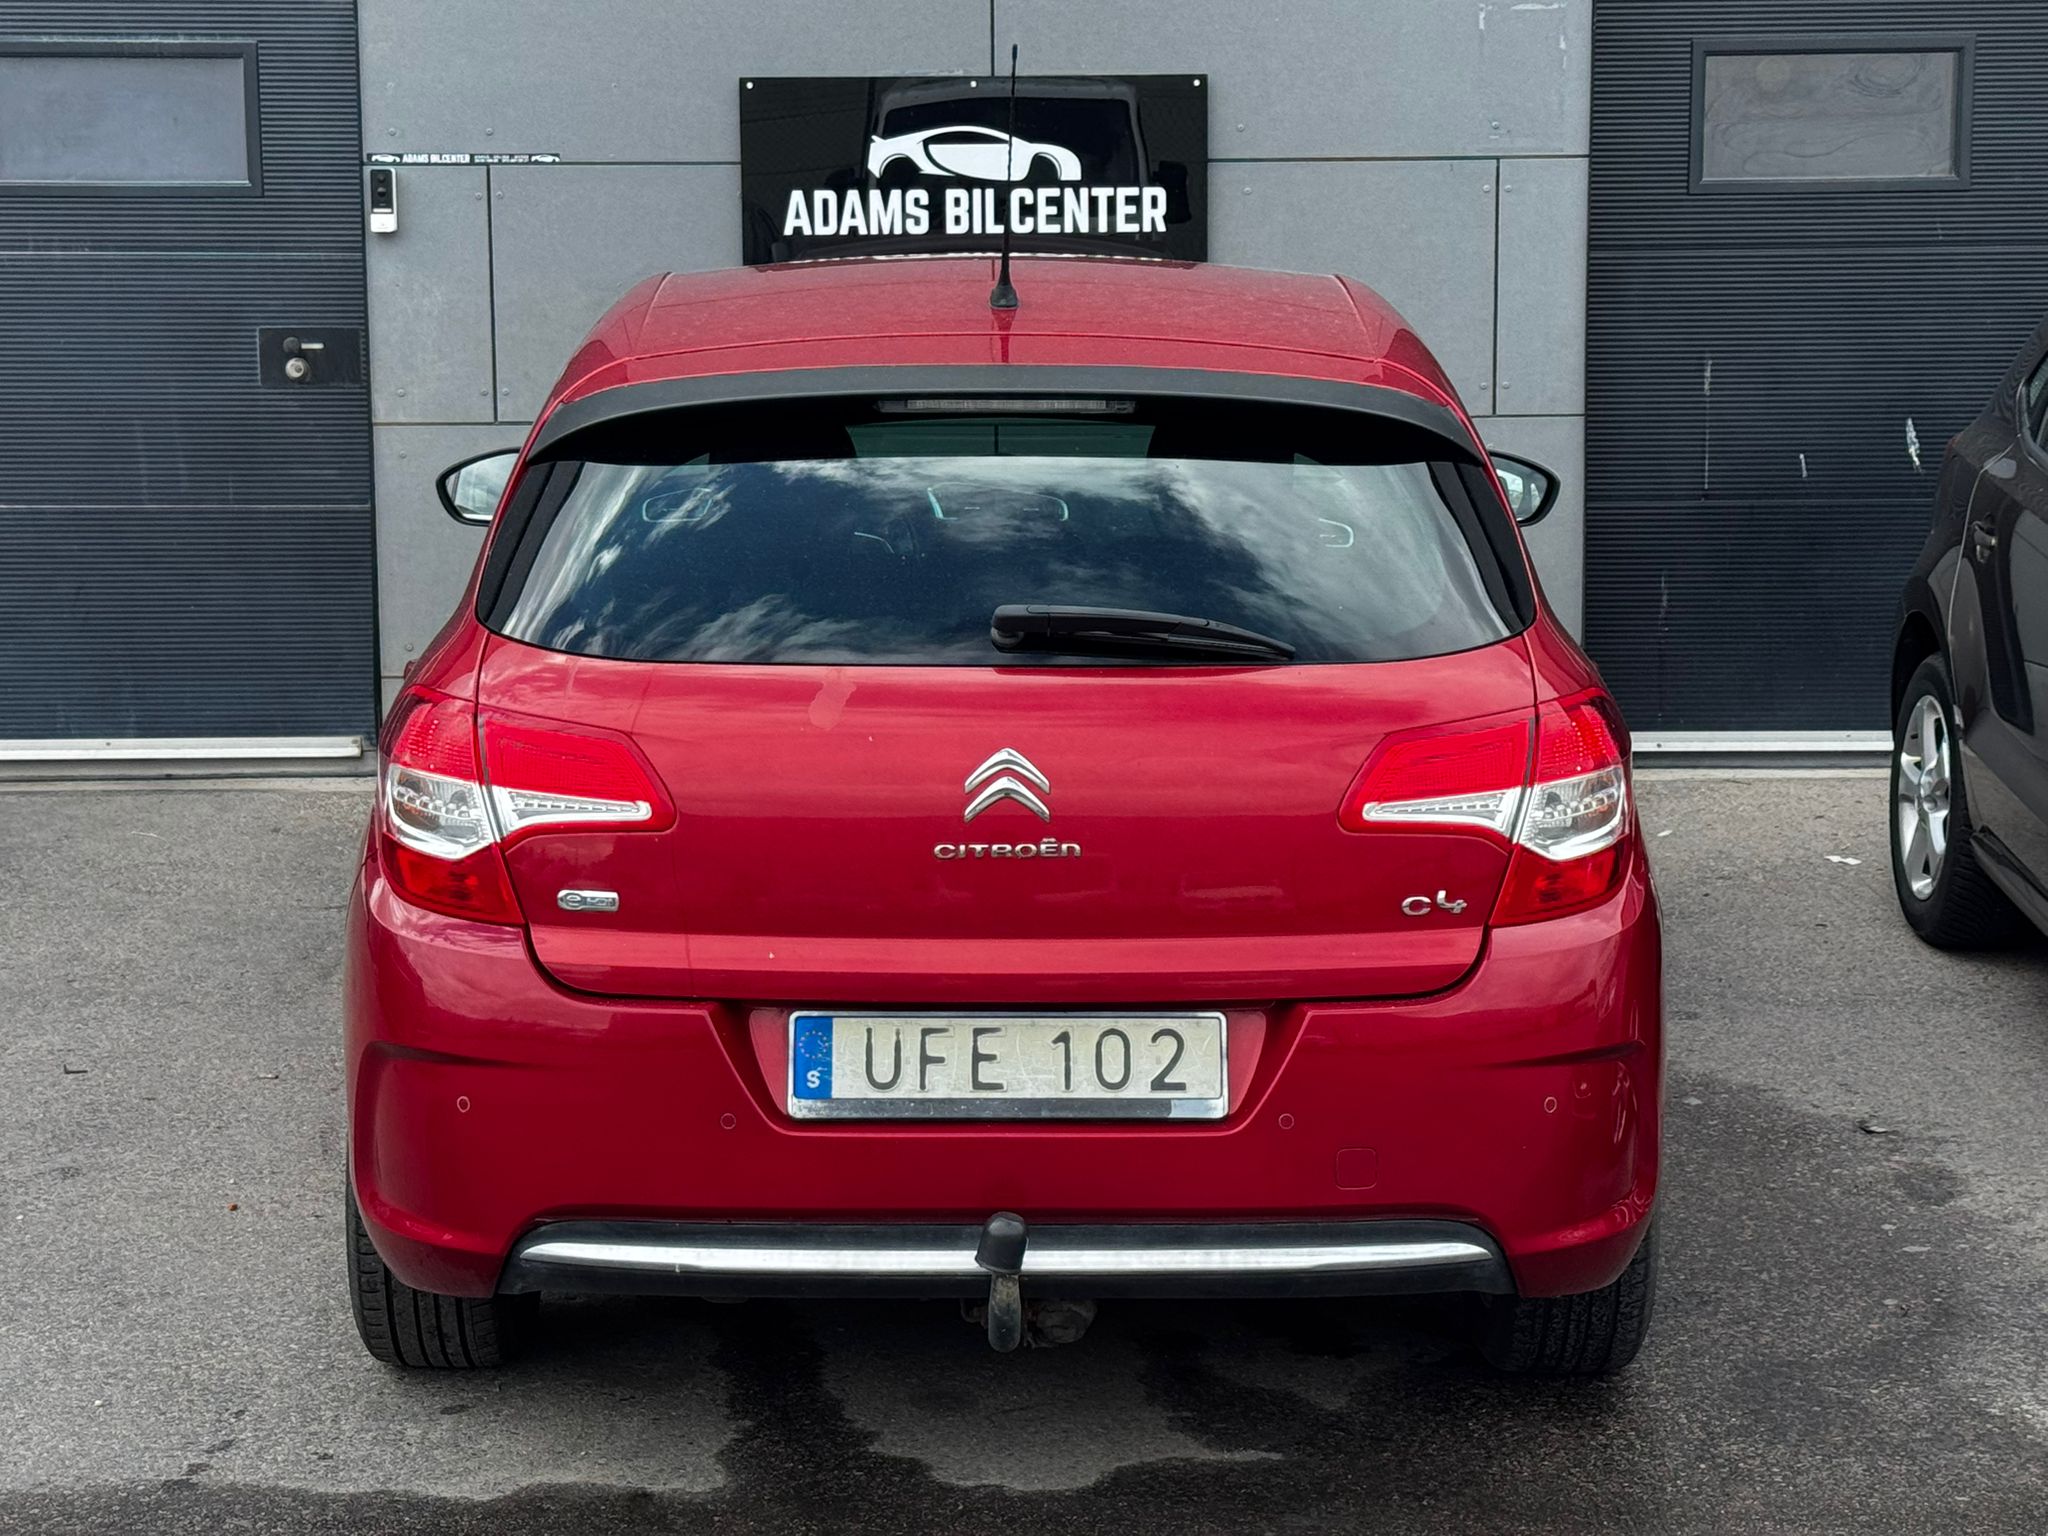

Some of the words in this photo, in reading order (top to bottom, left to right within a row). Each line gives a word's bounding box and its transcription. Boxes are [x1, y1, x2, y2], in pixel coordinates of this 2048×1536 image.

[784, 188, 929, 237] ADAMS
[945, 186, 1168, 235] BILCENTER
[1401, 890, 1468, 916] C4
[864, 1026, 1007, 1092] UFE
[1051, 1026, 1188, 1092] 102
[806, 1069, 821, 1089] S
